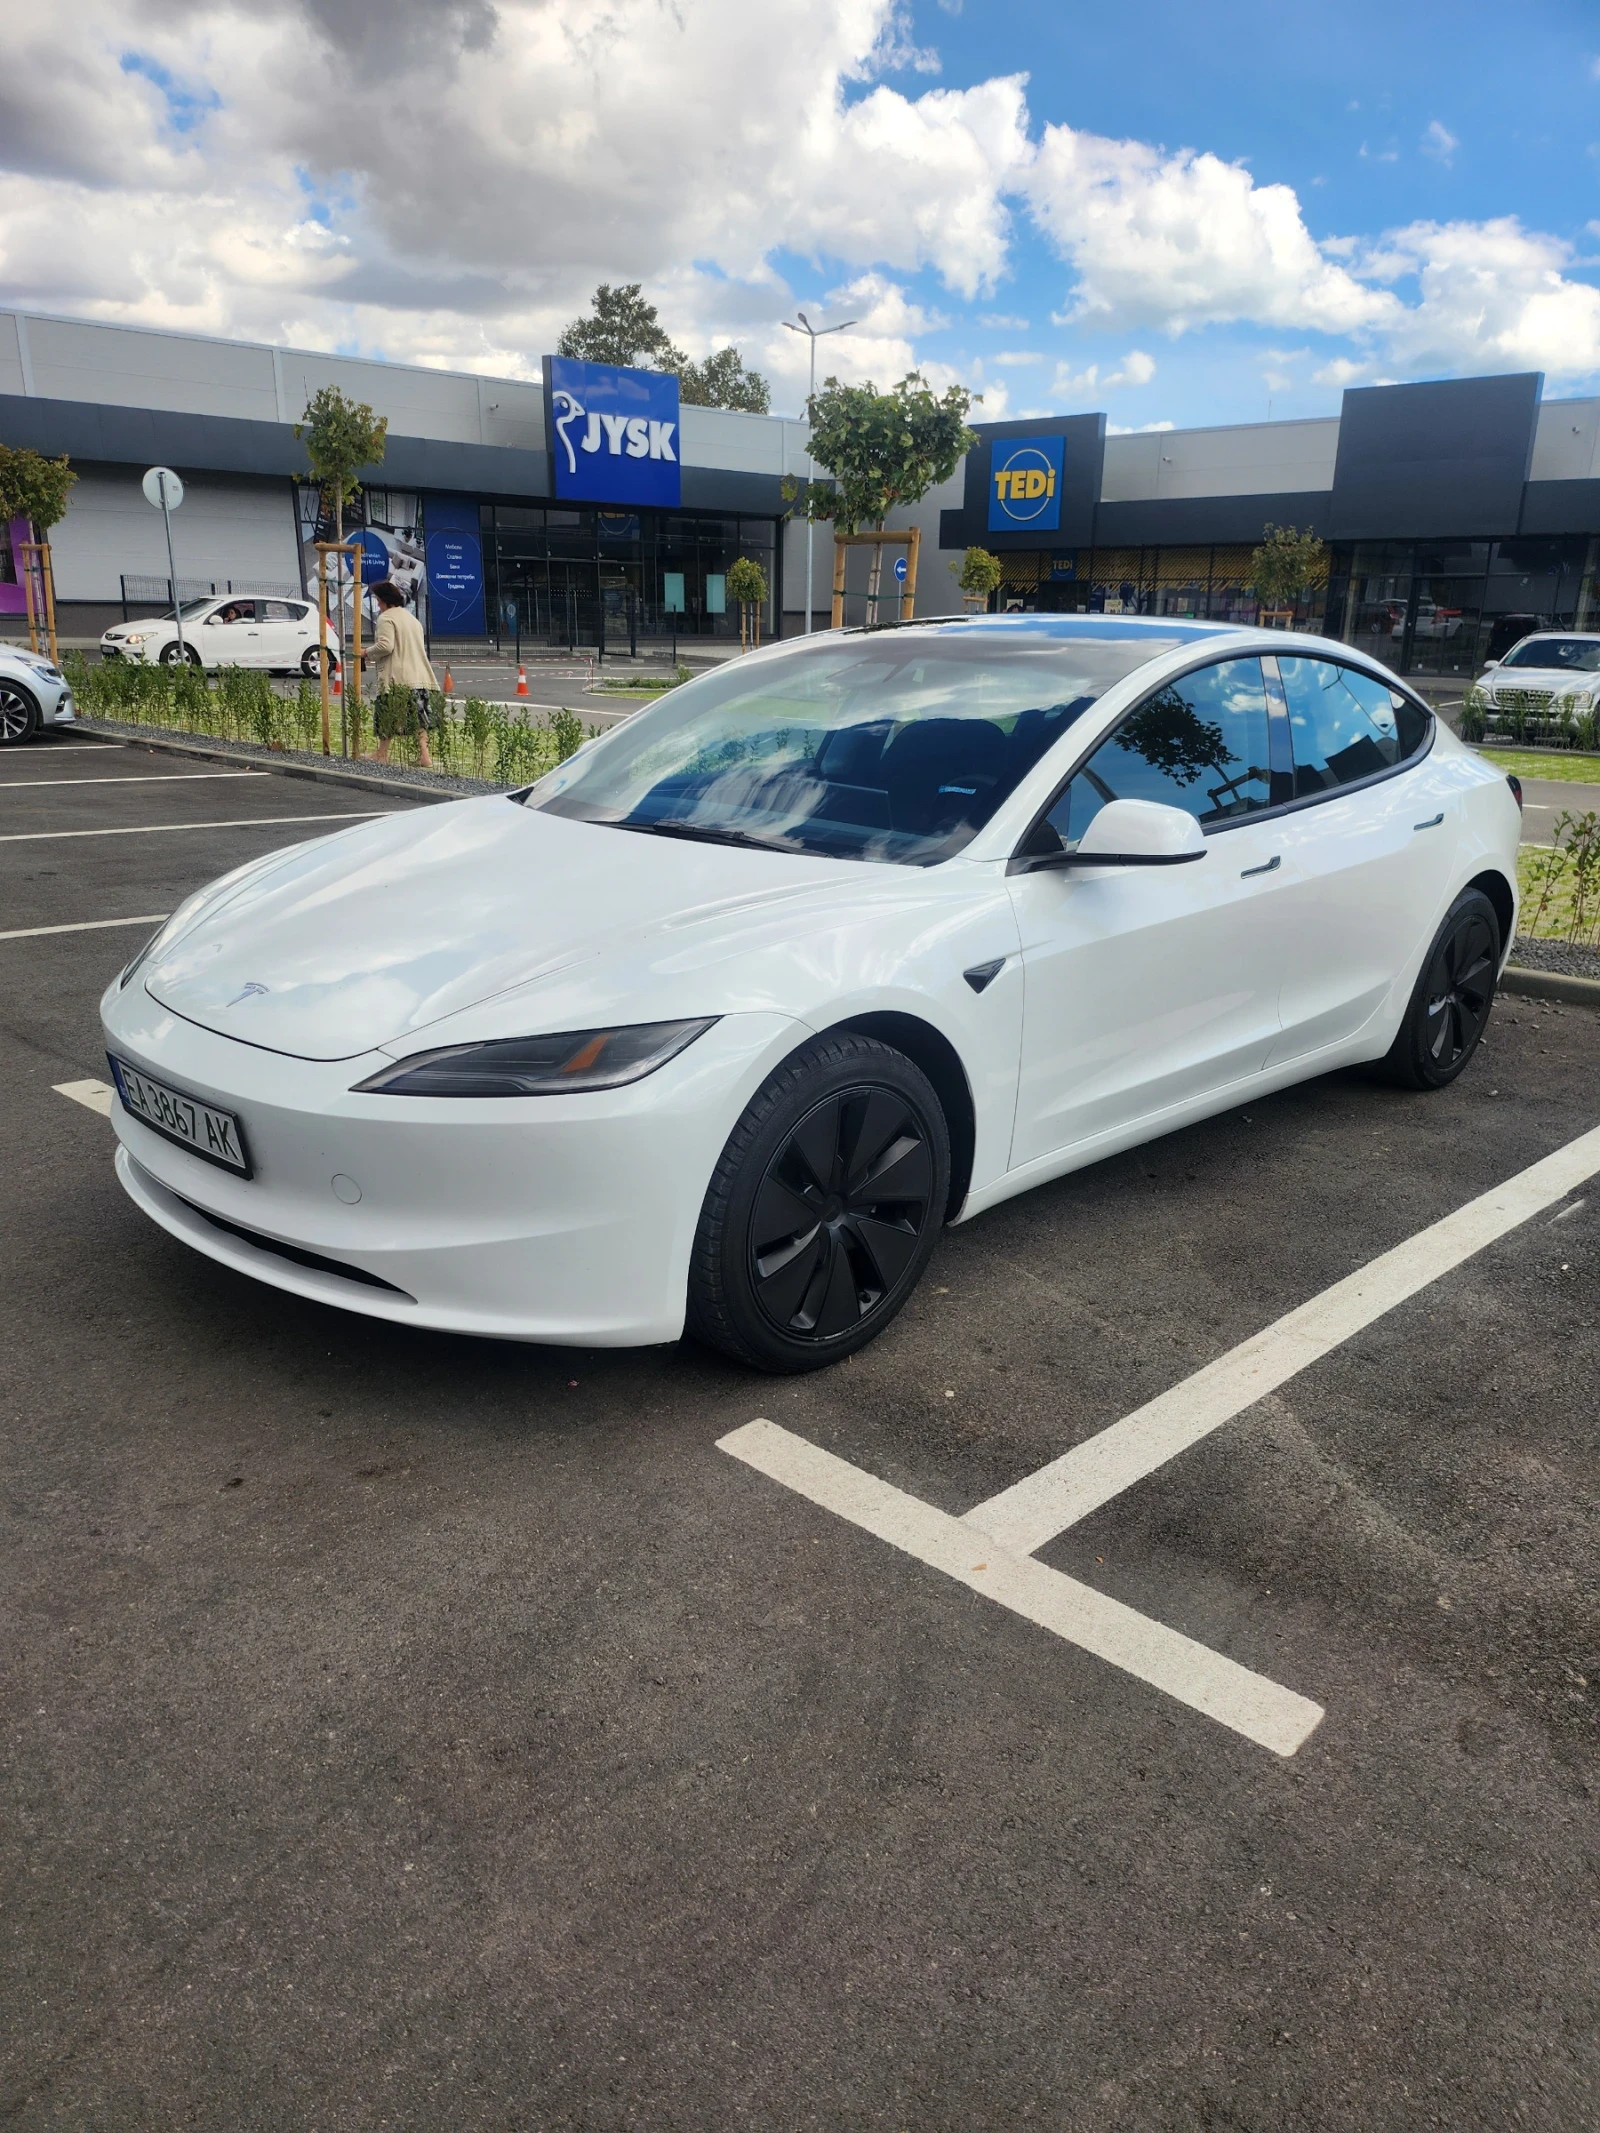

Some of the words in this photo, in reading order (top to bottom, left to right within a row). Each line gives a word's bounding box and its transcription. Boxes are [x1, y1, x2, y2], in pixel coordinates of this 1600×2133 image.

[581, 412, 677, 461] JYSK
[995, 469, 1056, 500] TEDi
[204, 1111, 240, 1161] AK
